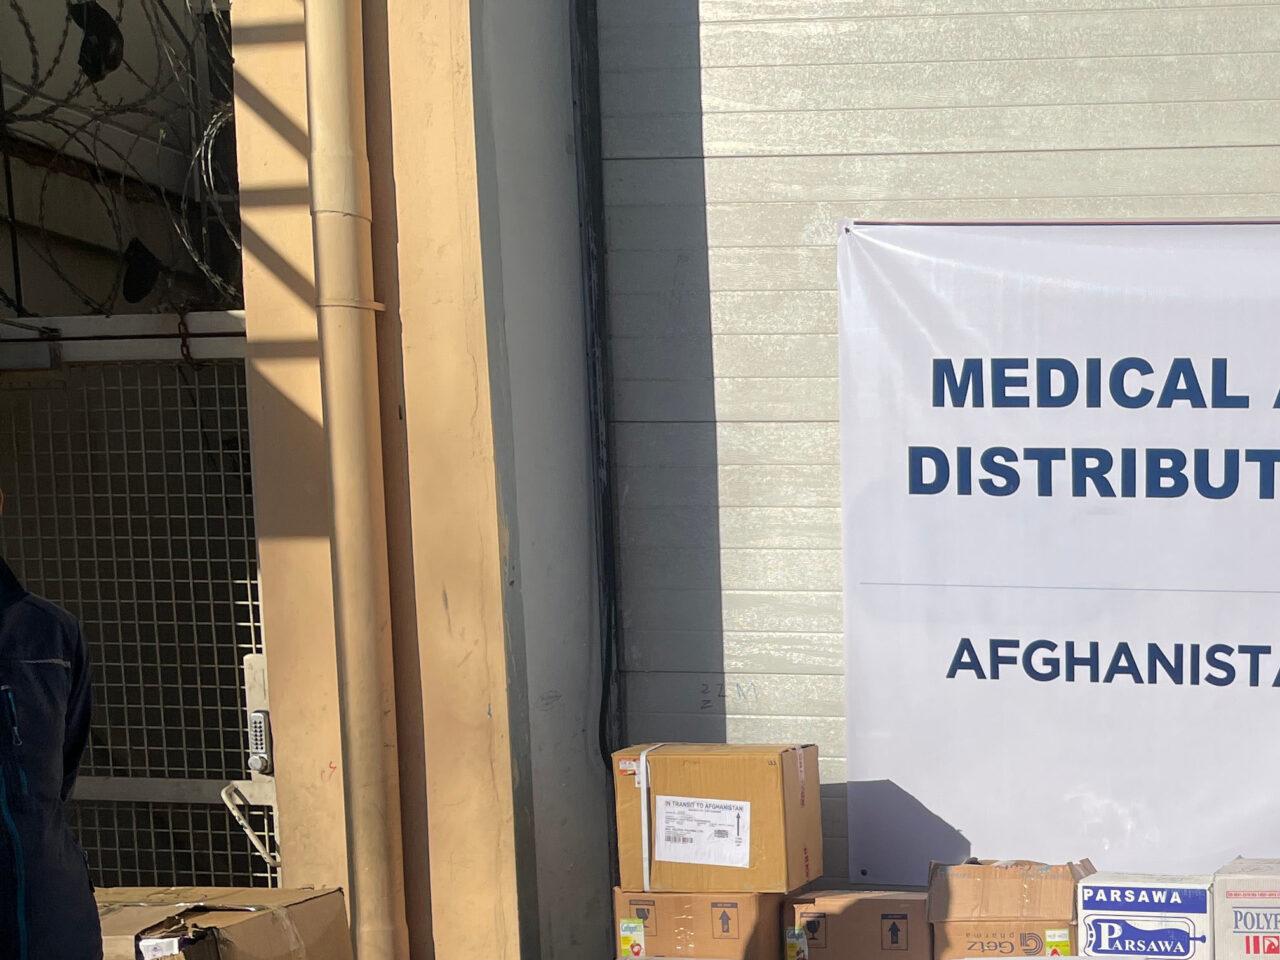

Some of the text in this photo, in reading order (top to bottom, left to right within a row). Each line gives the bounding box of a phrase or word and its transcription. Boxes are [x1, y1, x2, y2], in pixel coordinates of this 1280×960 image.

[931, 357, 1250, 409] MEDICAL
[705, 803, 744, 811] AFGHANISTAN
[1083, 888, 1183, 904] PARSAWA
[965, 931, 1015, 940] pharma
[1098, 922, 1186, 953] PARSAWA
[967, 940, 1015, 954] Getz
